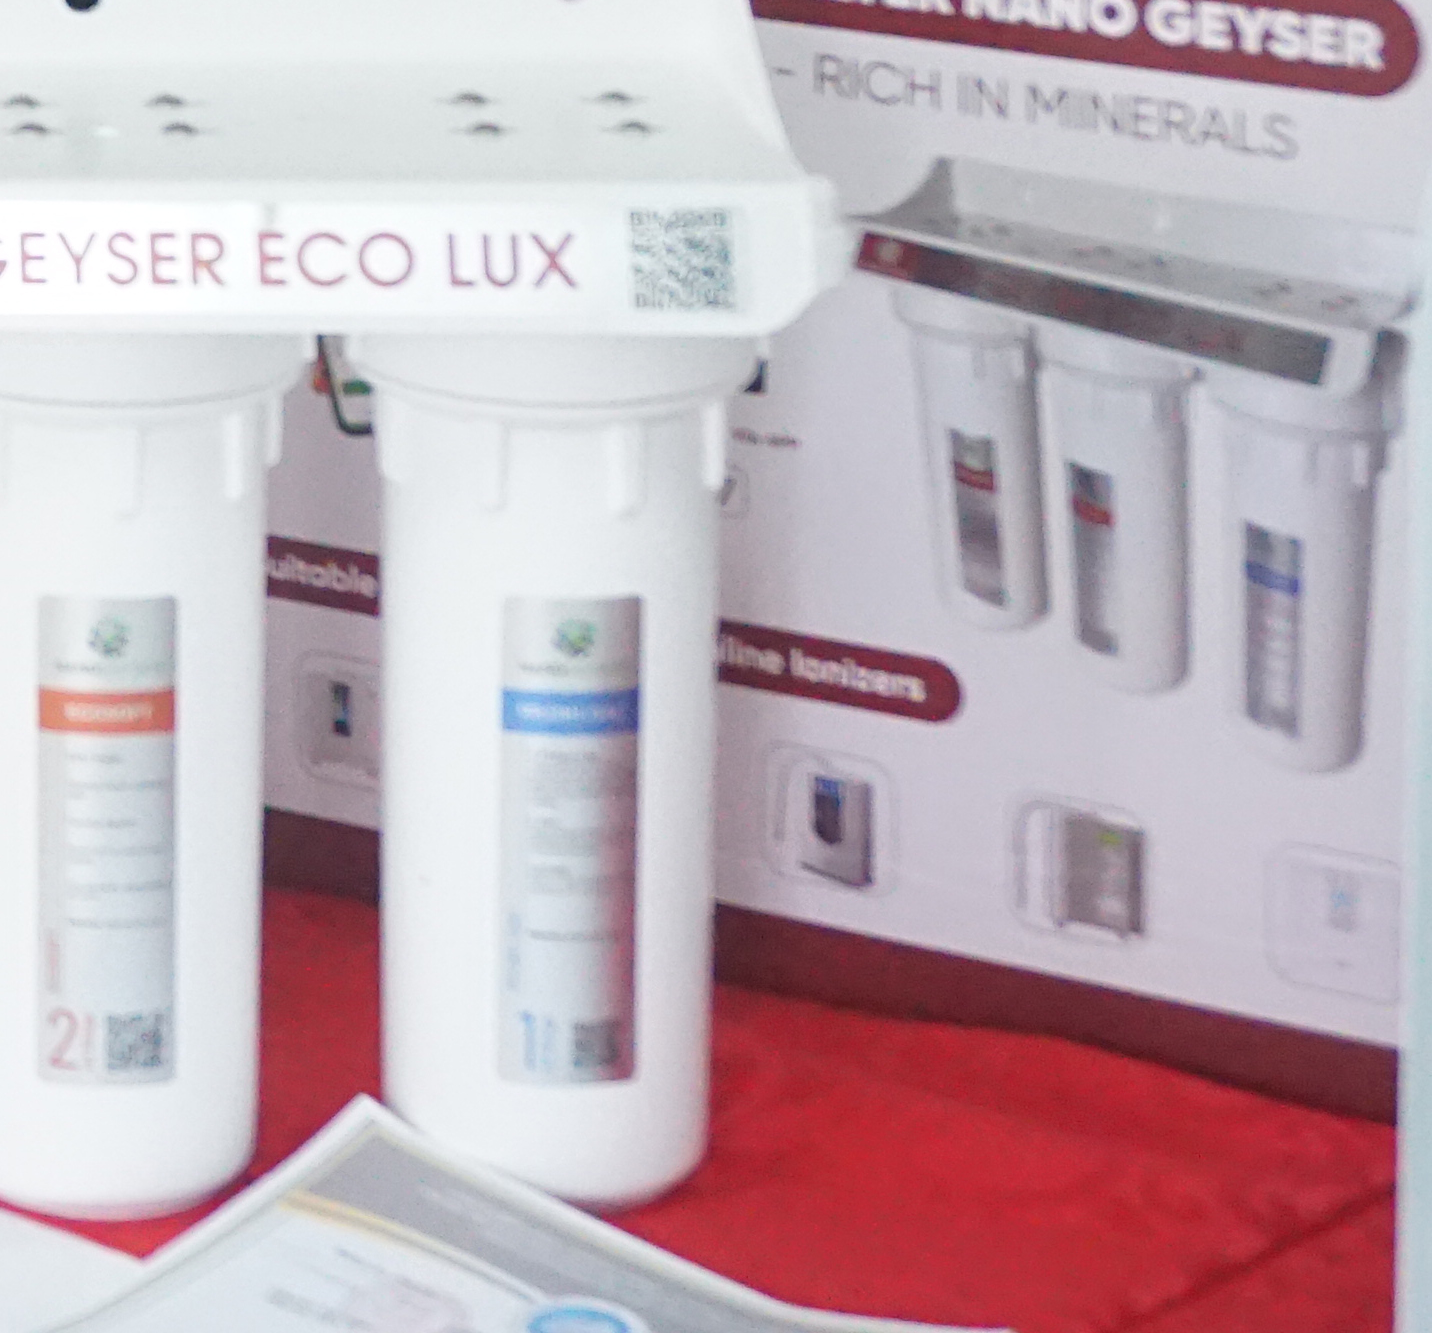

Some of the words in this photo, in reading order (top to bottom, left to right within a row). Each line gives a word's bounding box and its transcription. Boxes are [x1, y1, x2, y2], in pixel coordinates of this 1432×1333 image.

[811, 50, 943, 111] RICH
[956, 71, 1010, 120] IN
[1025, 82, 1300, 161] MINERALS
[257, 231, 413, 287] ECO
[447, 232, 577, 288] LUX
[46, 1005, 81, 1072] 2
